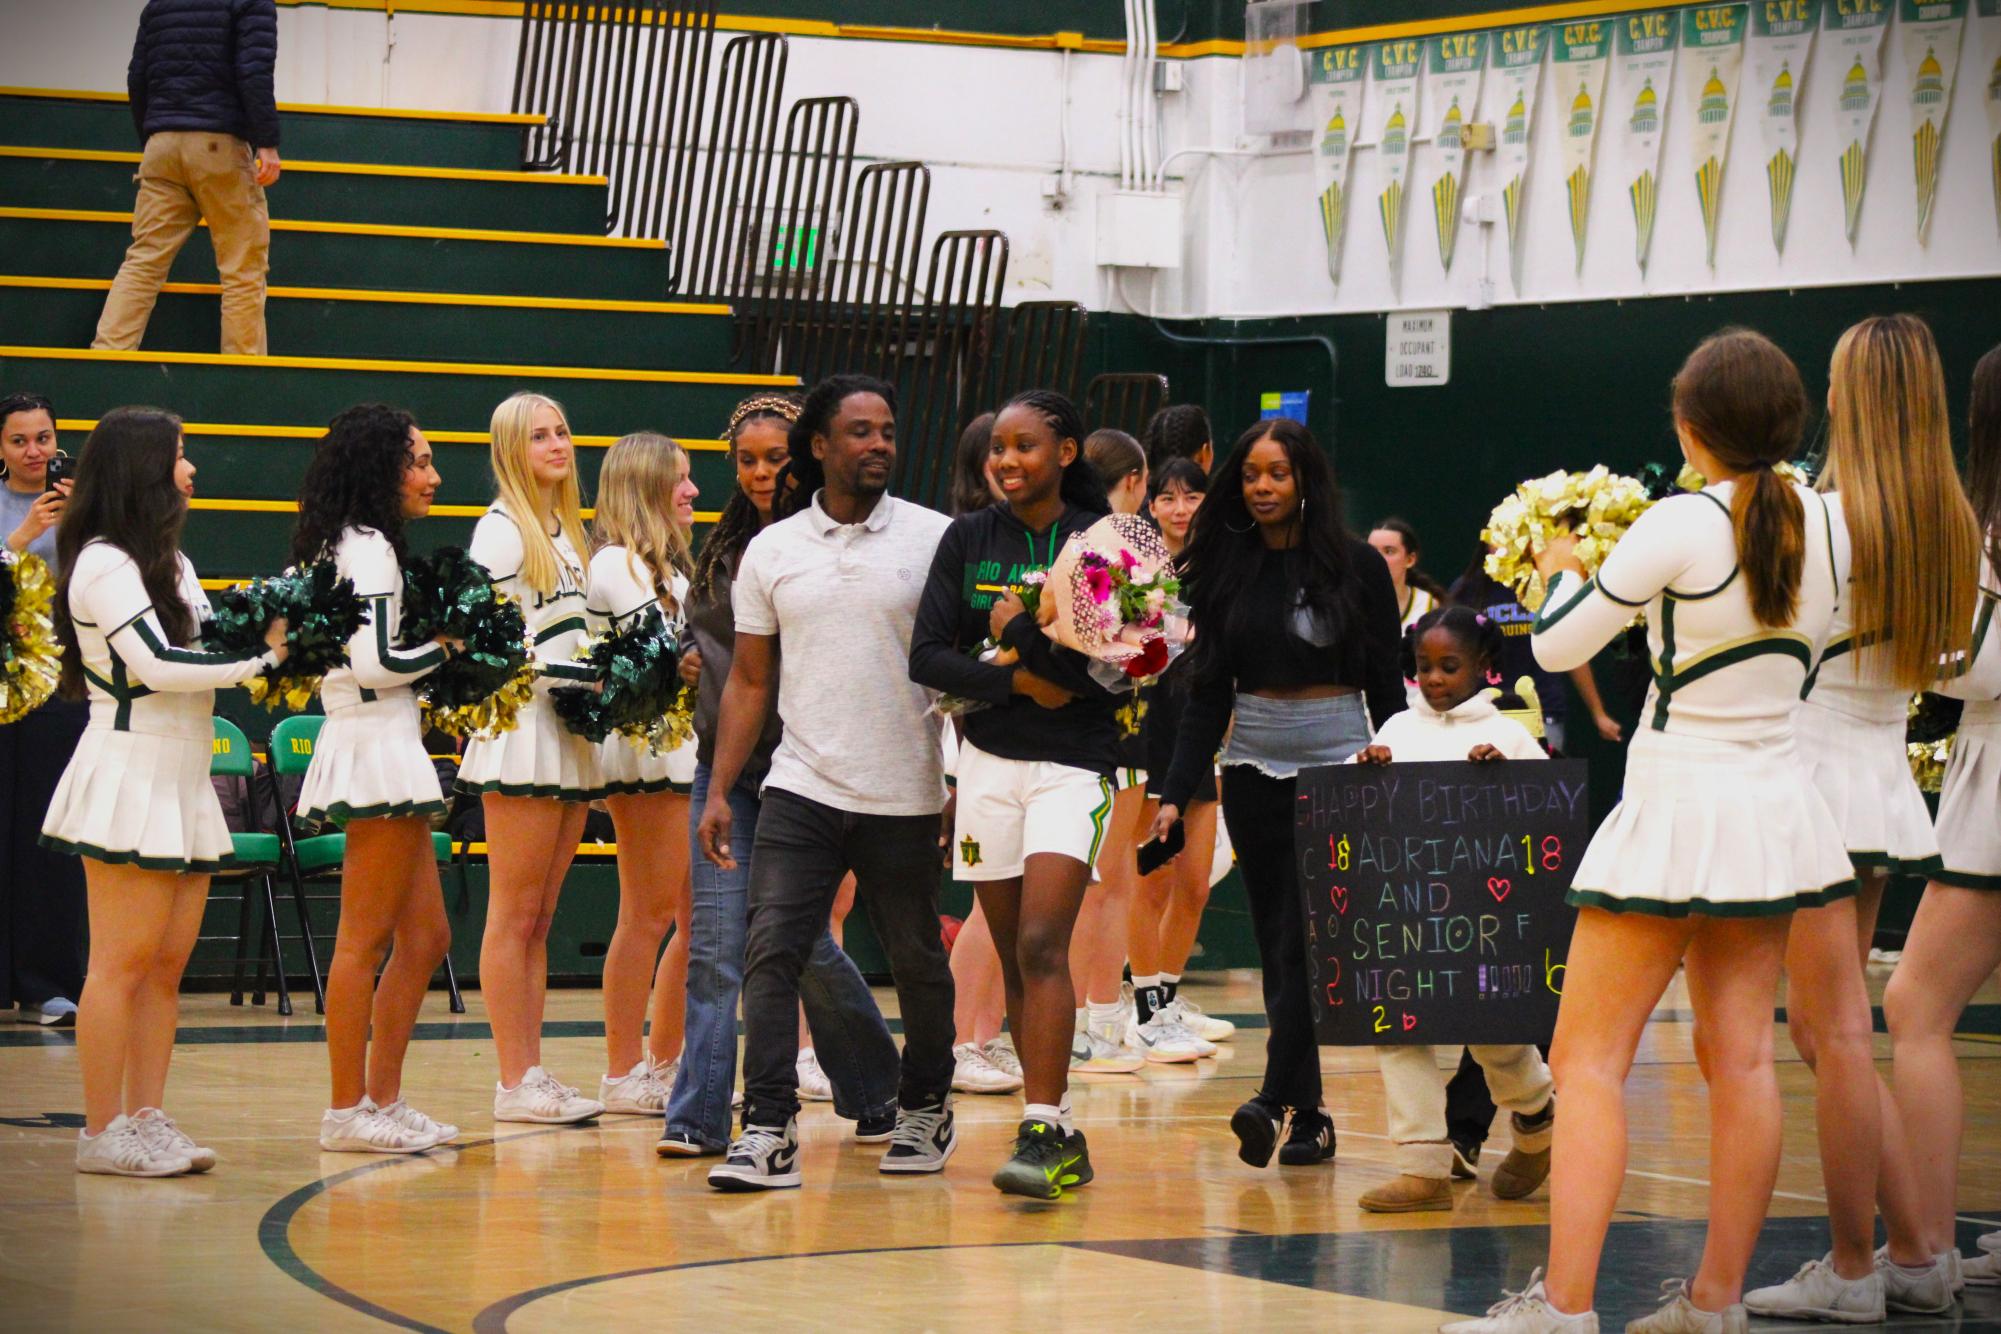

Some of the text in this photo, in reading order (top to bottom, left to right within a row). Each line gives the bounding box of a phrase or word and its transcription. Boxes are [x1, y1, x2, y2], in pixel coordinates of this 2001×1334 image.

[1400, 341, 1435, 355] OCCUPANT
[1395, 363, 1413, 378] LOAD
[976, 560, 1001, 581] RIO
[291, 737, 312, 755] RIO
[1311, 776, 1400, 830] HAPPY
[1418, 779, 1586, 826] BIRTHDAY
[1358, 831, 1518, 876] ADRIANA
[1520, 833, 1562, 875] 18
[1378, 881, 1451, 913] AND
[1352, 914, 1501, 960] SENIOR
[1355, 968, 1463, 1003] NIGHT
